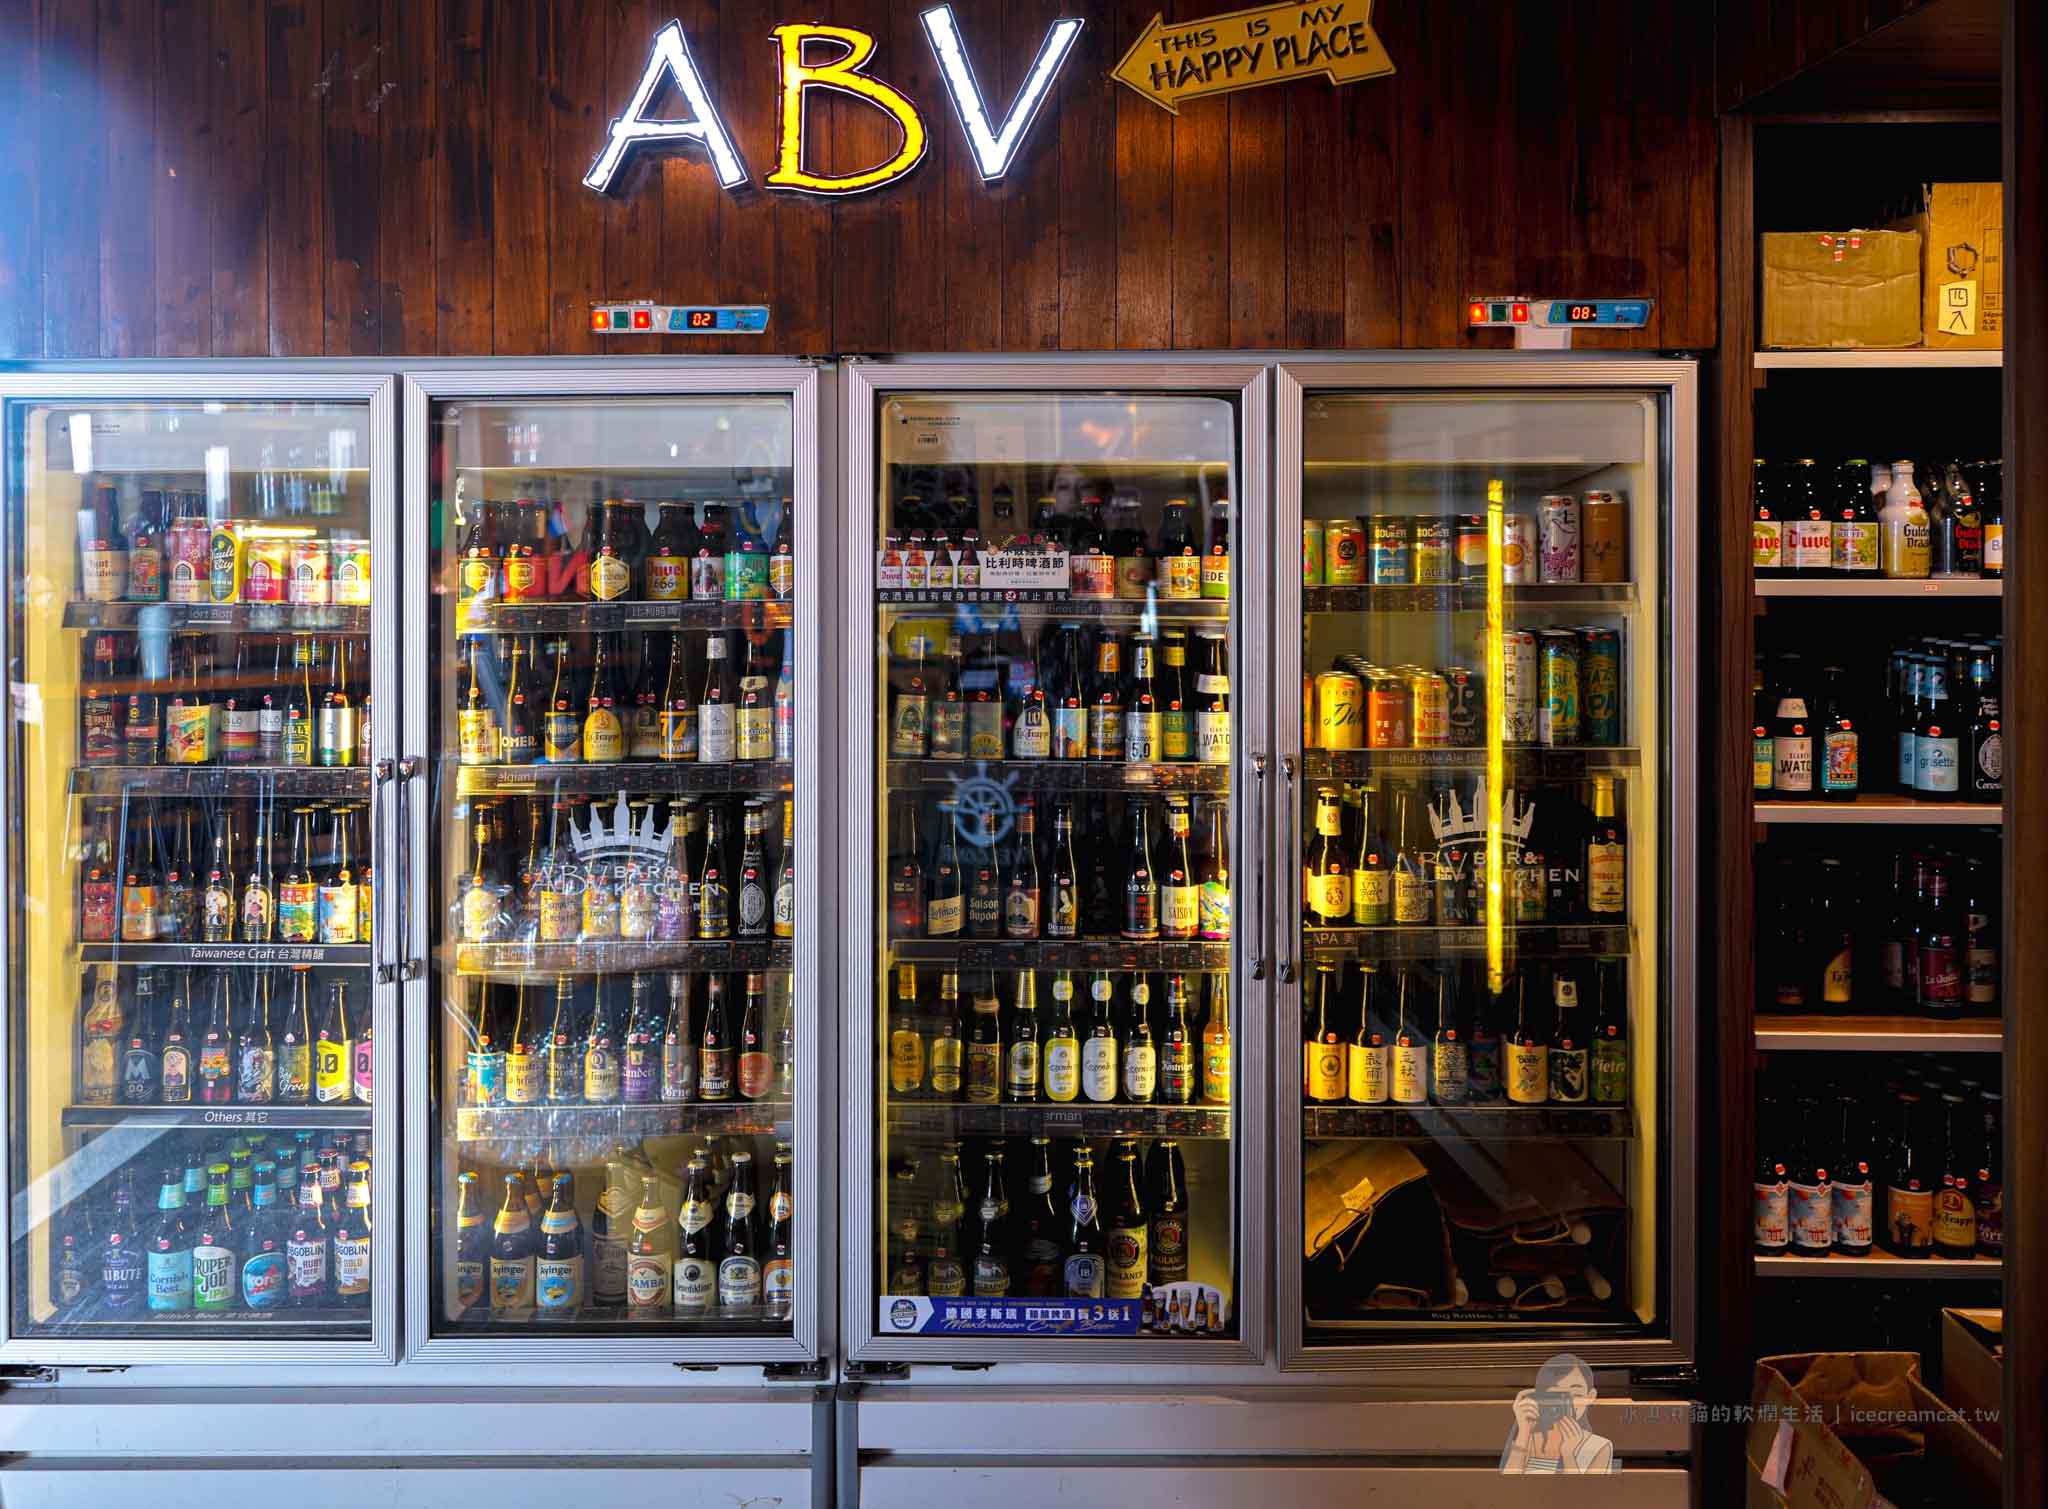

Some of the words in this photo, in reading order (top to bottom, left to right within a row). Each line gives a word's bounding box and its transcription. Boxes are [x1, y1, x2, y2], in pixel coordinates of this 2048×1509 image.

[1154, 28, 1217, 55] THIS
[1246, 18, 1271, 39] IS
[1300, 3, 1345, 29] MY
[1149, 43, 1265, 91] HAPPY
[1272, 22, 1369, 70] PLACE
[692, 312, 711, 326] 02
[985, 557, 1064, 569] 比利時啤酒節
[1473, 868, 1581, 882] KTCHEN
[191, 948, 245, 960] Taiwanese
[248, 948, 275, 960] Craft
[204, 1111, 242, 1123] Others
[200, 1273, 228, 1293] JOB
